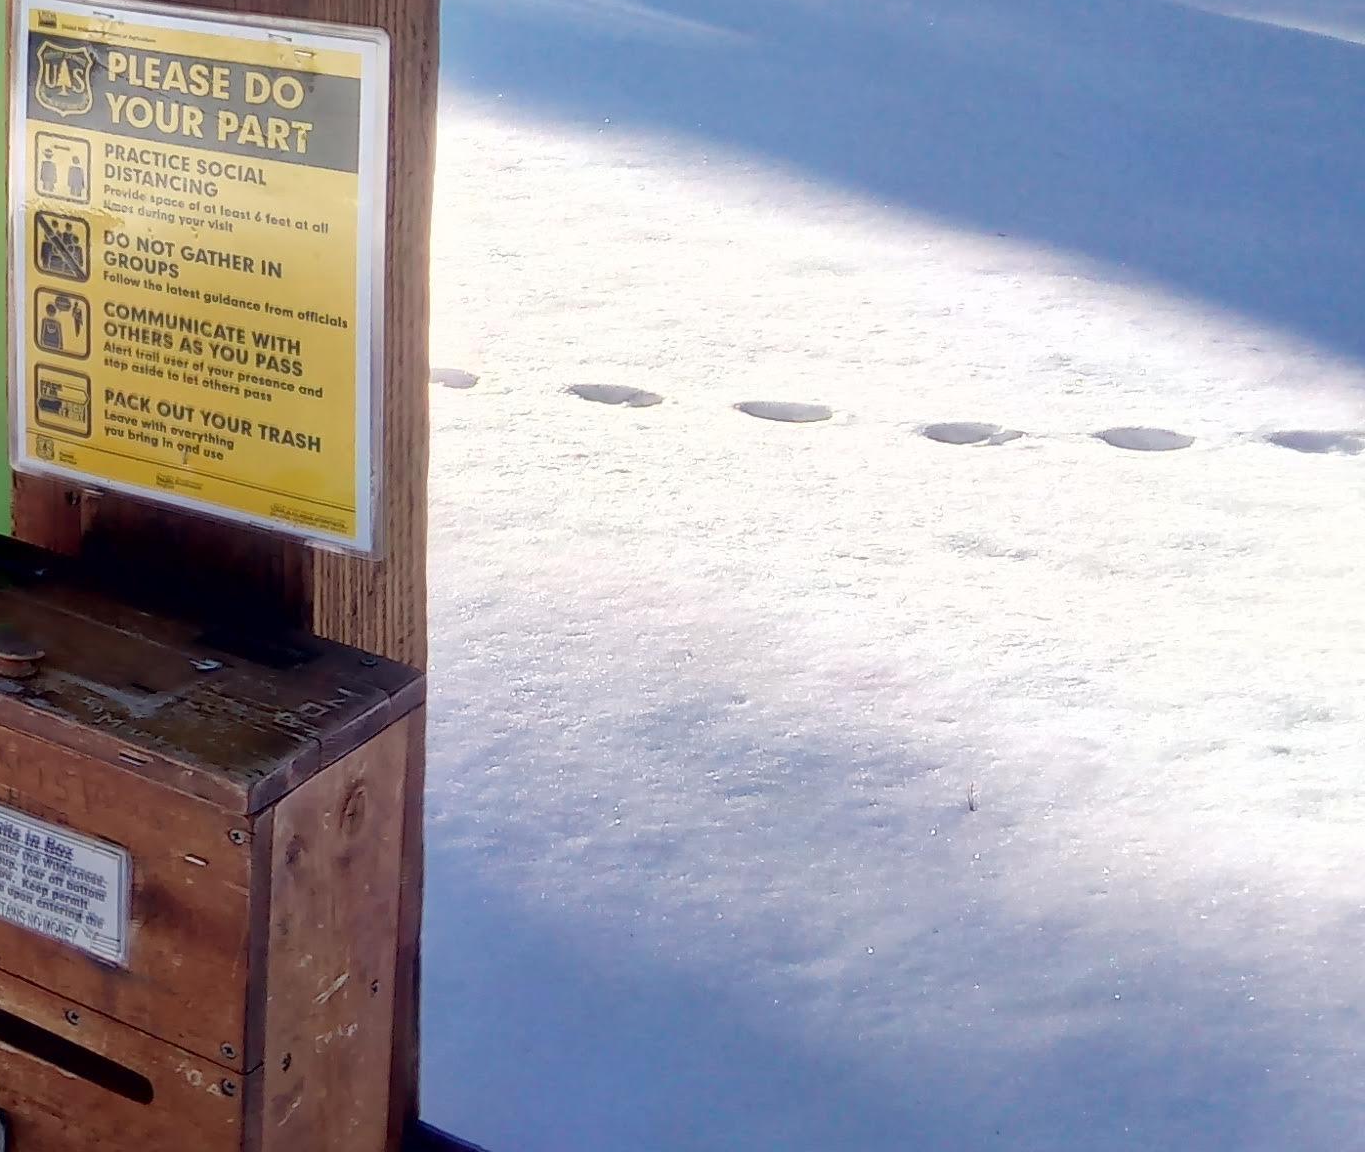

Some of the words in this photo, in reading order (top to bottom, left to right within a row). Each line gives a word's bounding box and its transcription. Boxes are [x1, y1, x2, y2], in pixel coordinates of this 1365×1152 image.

[107, 51, 230, 100] PLEASE
[245, 71, 303, 109] DO
[105, 92, 203, 139] YOUR
[218, 109, 312, 154] PART
[105, 142, 190, 173] PRACTICE
[197, 158, 266, 187] SOCIAL
[105, 163, 218, 198] DISTANCING
[104, 230, 129, 250] DO
[137, 236, 175, 258] NOT
[181, 245, 254, 274] GATHER
[261, 259, 281, 279] IN
[104, 250, 179, 279] GROUPS
[103, 270, 140, 288] Follow
[144, 278, 162, 292] the
[167, 281, 200, 300] latest
[204, 292, 260, 312] guidance
[265, 301, 293, 319] from
[297, 310, 347, 329] officials
[104, 301, 245, 345] COMMUNICATE
[252, 331, 300, 357] WITH
[104, 321, 173, 350] OTHERS
[179, 336, 203, 356] AS
[209, 342, 248, 366] YOU
[256, 351, 302, 377] PASS
[105, 388, 150, 414] PACK
[157, 400, 195, 423] OUT
[200, 409, 252, 438] YOUR
[258, 423, 321, 454] TRASH
